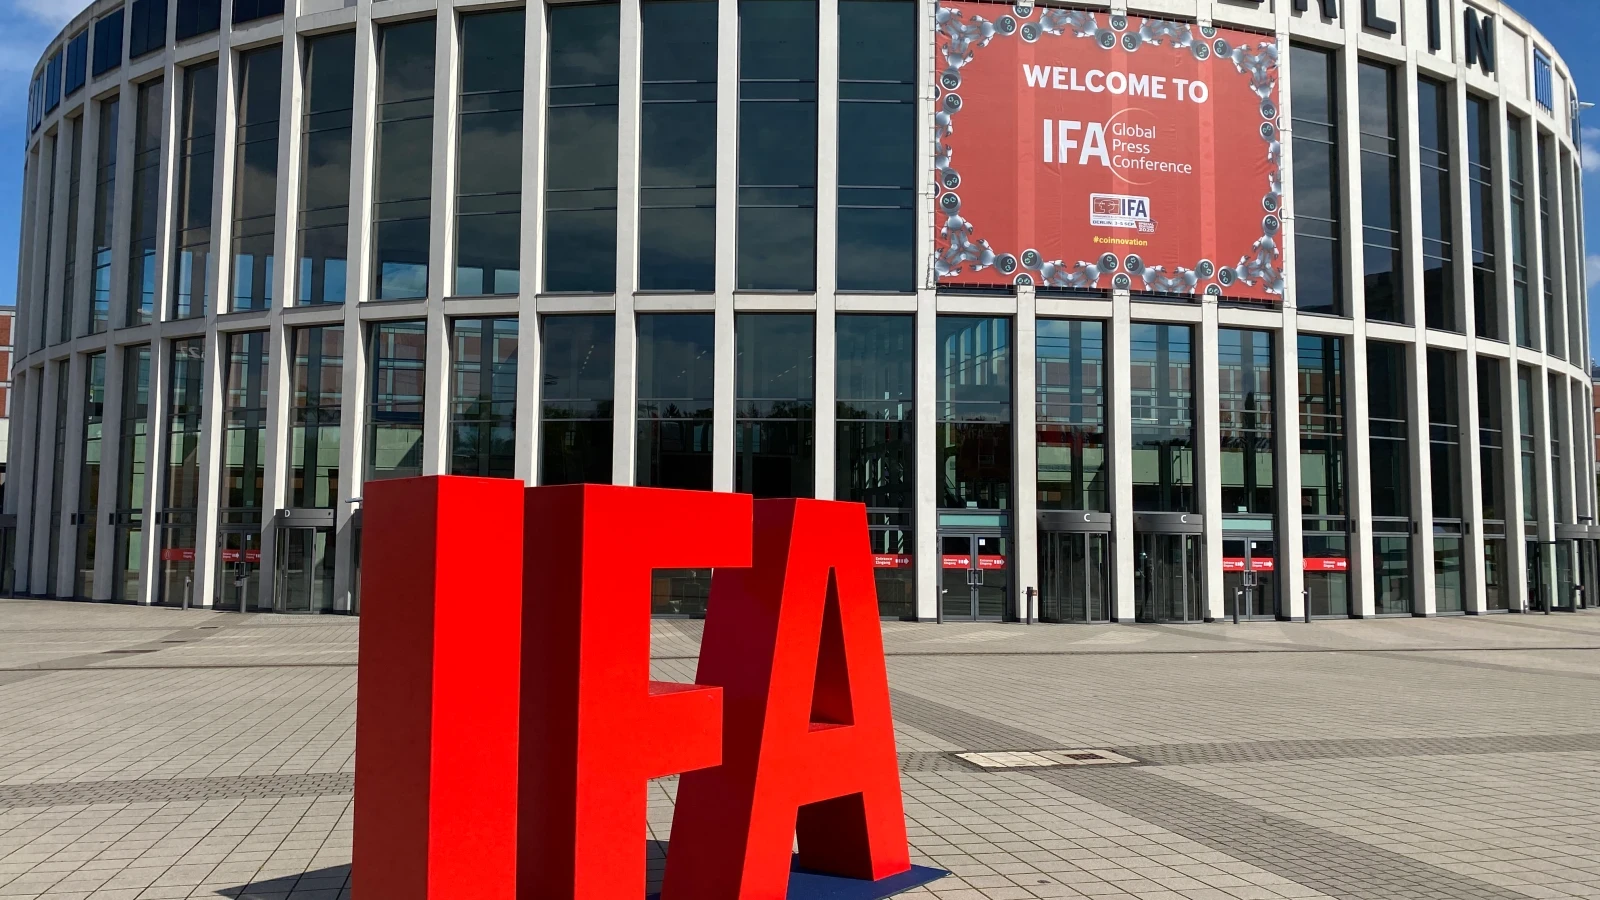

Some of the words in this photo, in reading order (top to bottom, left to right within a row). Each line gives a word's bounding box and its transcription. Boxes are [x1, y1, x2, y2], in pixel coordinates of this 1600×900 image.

[1022, 64, 1167, 99] WELCOME
[1172, 78, 1209, 104] TO
[1112, 122, 1156, 139] Global
[1043, 118, 1111, 167] IFA
[1112, 139, 1150, 154] Press
[1112, 154, 1192, 174] Conference
[1122, 198, 1148, 217] IFA
[1093, 236, 1148, 246] #coinnovation
[284, 510, 290, 518] D
[1084, 513, 1091, 522] C
[1180, 514, 1187, 523] C
[351, 475, 910, 900] IFA
